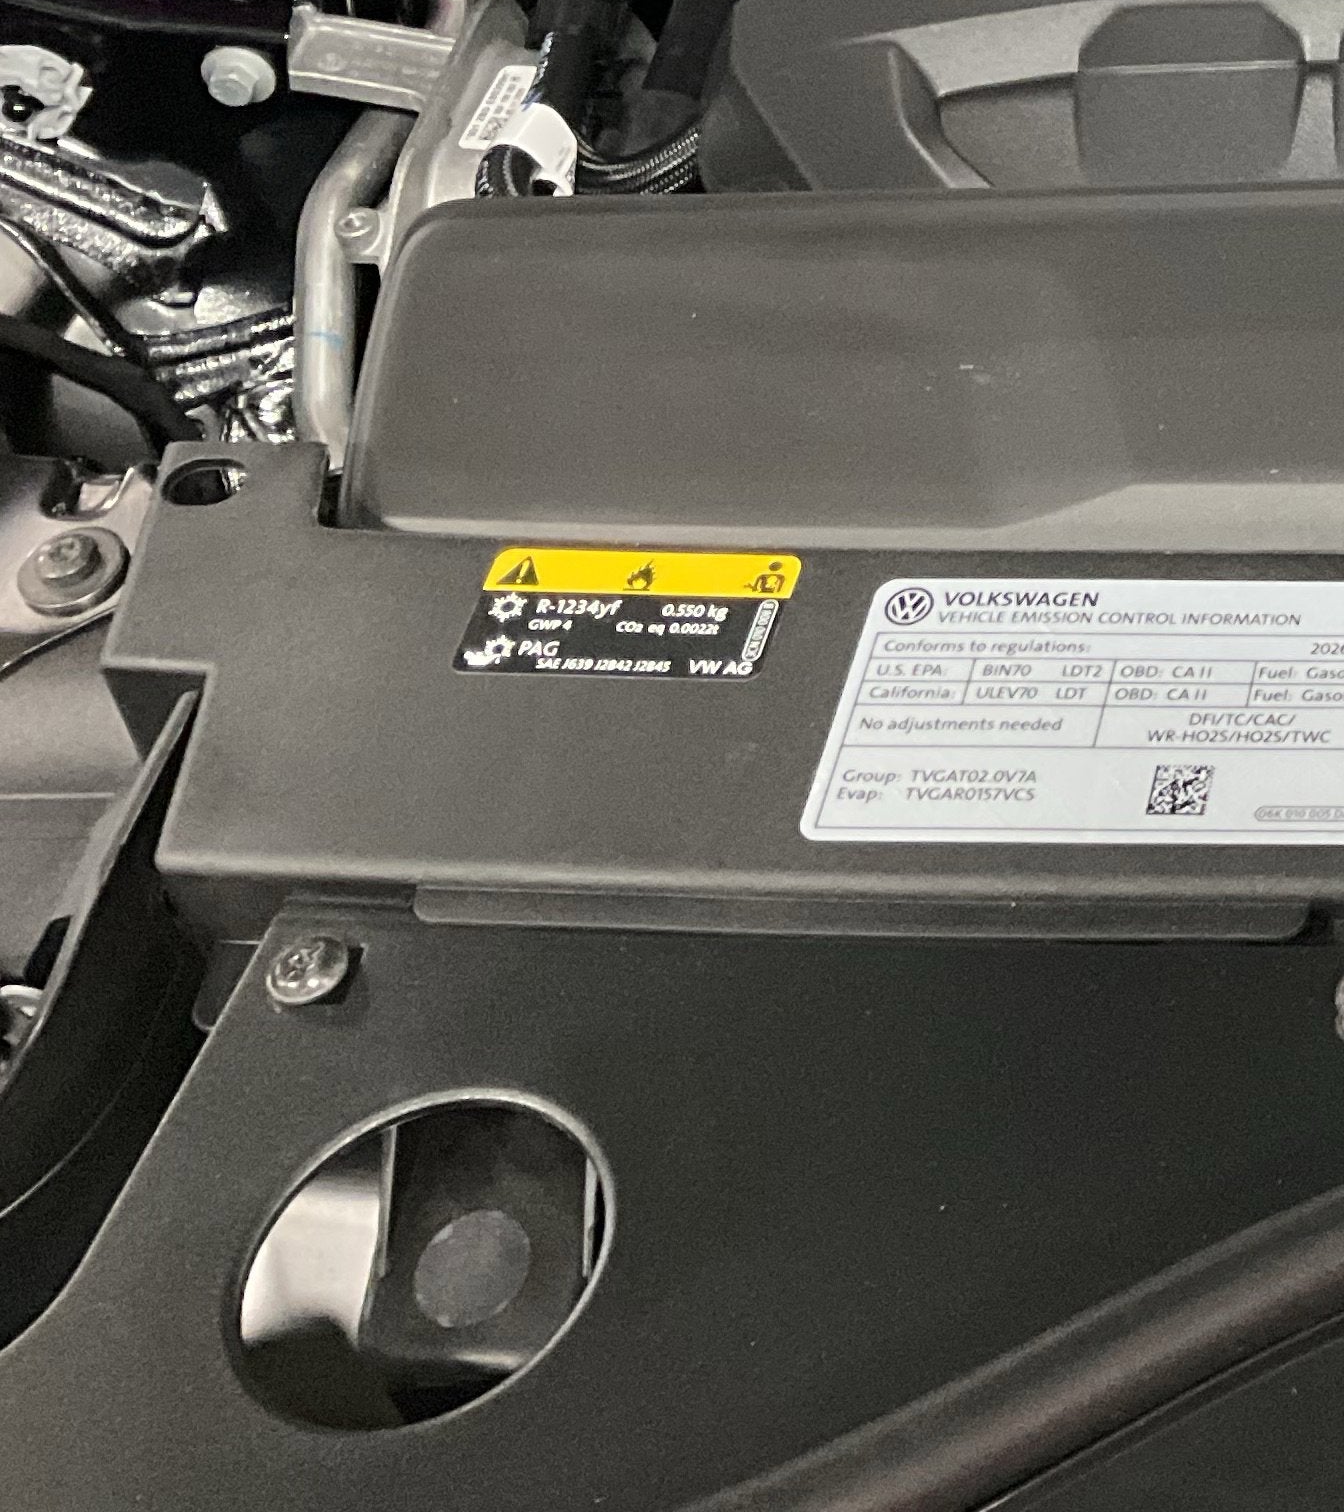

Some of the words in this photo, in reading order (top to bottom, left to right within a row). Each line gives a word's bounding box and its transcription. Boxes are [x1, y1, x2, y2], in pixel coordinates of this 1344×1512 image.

[944, 591, 1100, 607] VOLKSWAGEN
[536, 598, 623, 620] R-1234yf
[661, 603, 705, 618] 0.550
[707, 604, 729, 622] kg
[938, 611, 1006, 624] VEHICLE
[1011, 611, 1094, 624] EMISSION
[1098, 612, 1177, 625] CONTROL
[1181, 613, 1302, 626] INFORMATION
[528, 618, 562, 631] GWP
[562, 619, 573, 631] 4
[647, 623, 666, 637] eq
[517, 640, 561, 657] PAG
[883, 639, 964, 653] Conforms
[970, 640, 987, 653] to
[535, 657, 562, 670] SAE
[689, 659, 723, 675] VW
[722, 660, 754, 676] AG
[982, 663, 1032, 677] BIN70
[1062, 664, 1104, 678] LDT2
[976, 686, 1039, 699] ULEV70
[1055, 687, 1087, 700] LDT
[858, 717, 883, 730] No
[887, 717, 995, 734] adjustments
[999, 717, 1064, 731] needed
[1188, 712, 1297, 727] DFI/TC/CAC/
